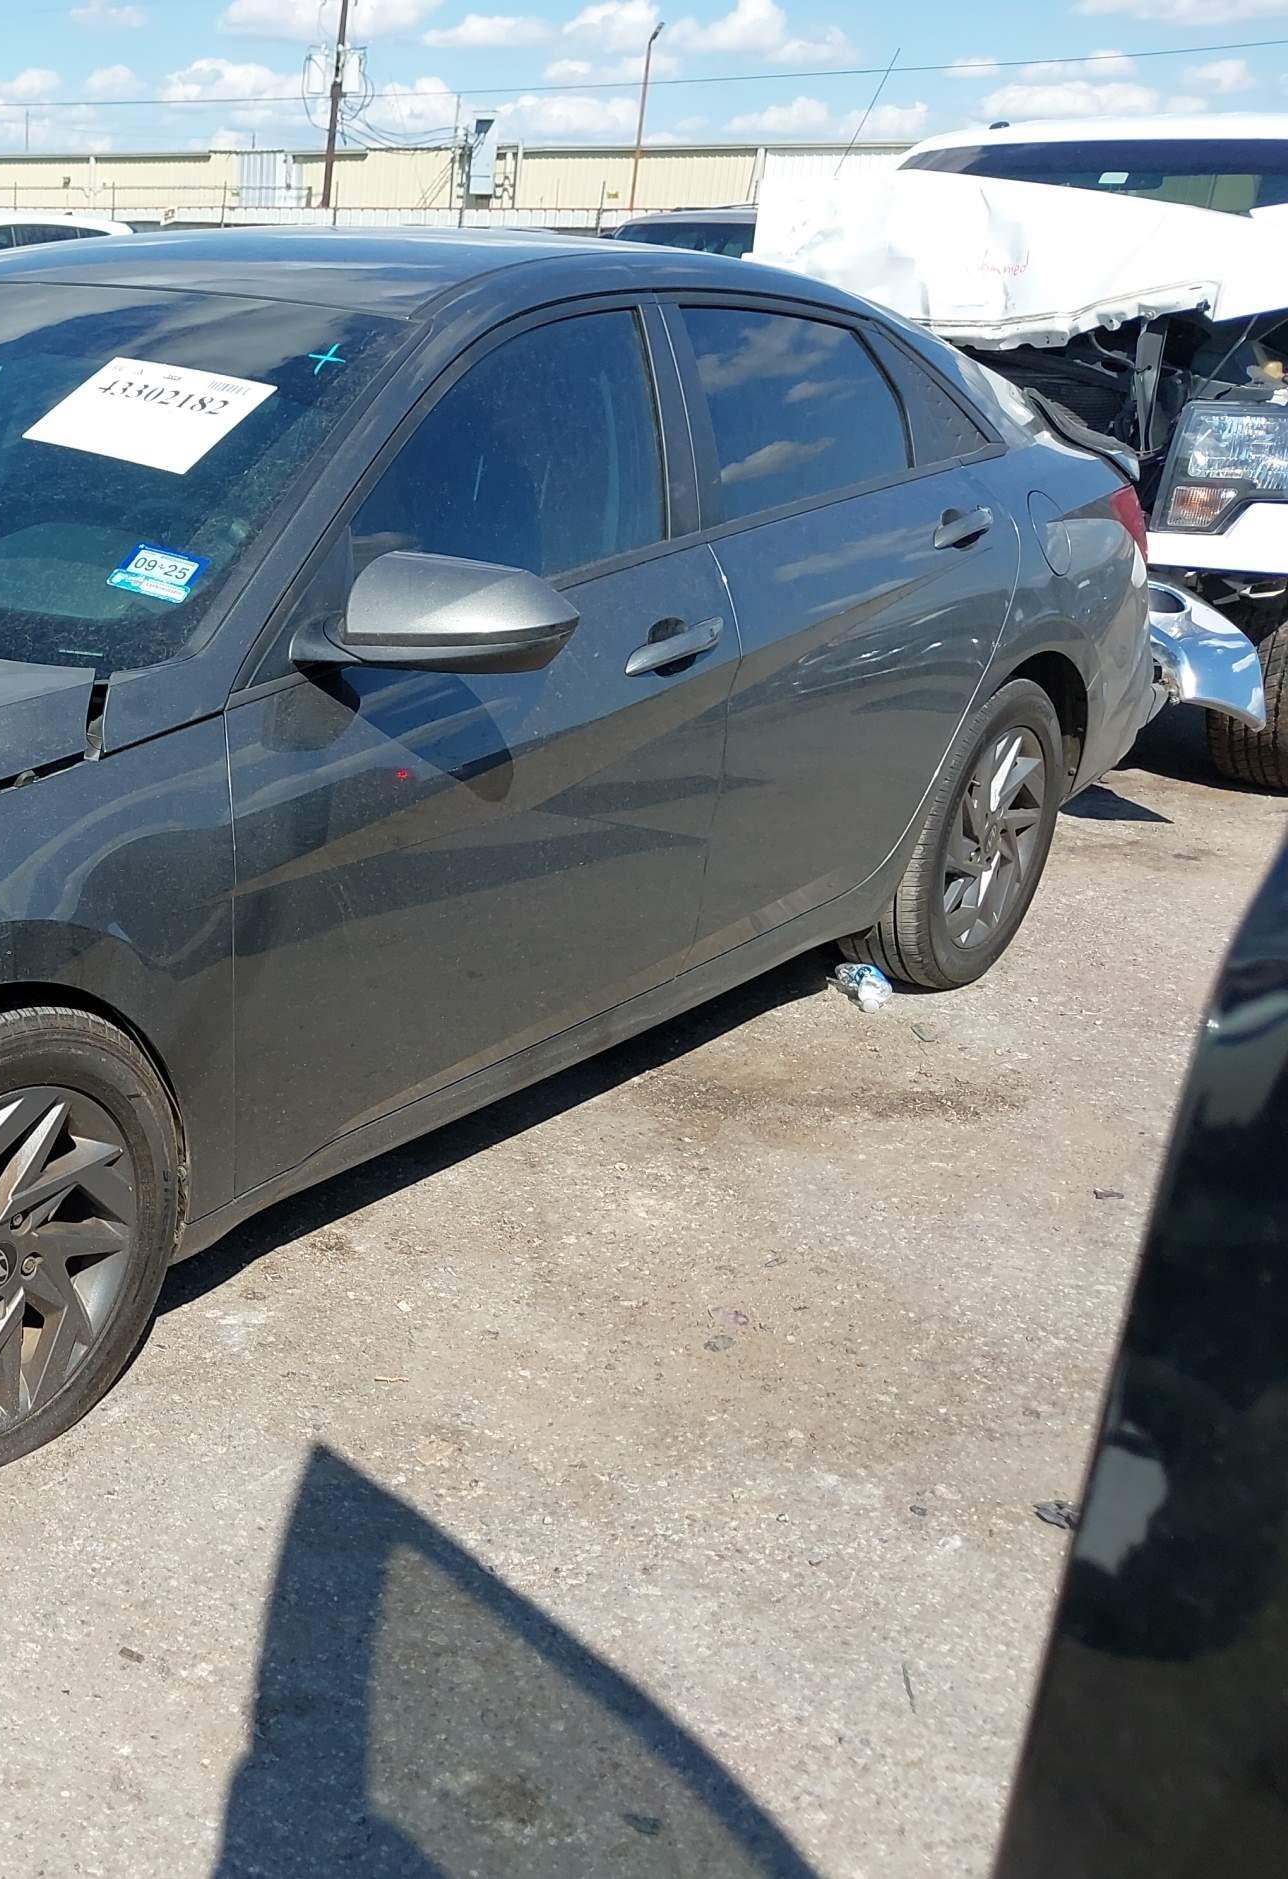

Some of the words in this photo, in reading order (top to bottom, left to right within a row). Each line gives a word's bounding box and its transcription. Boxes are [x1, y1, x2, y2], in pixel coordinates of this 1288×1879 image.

[98, 379, 230, 415] 43302182
[134, 557, 158, 572] 09
[163, 564, 190, 580] 25
